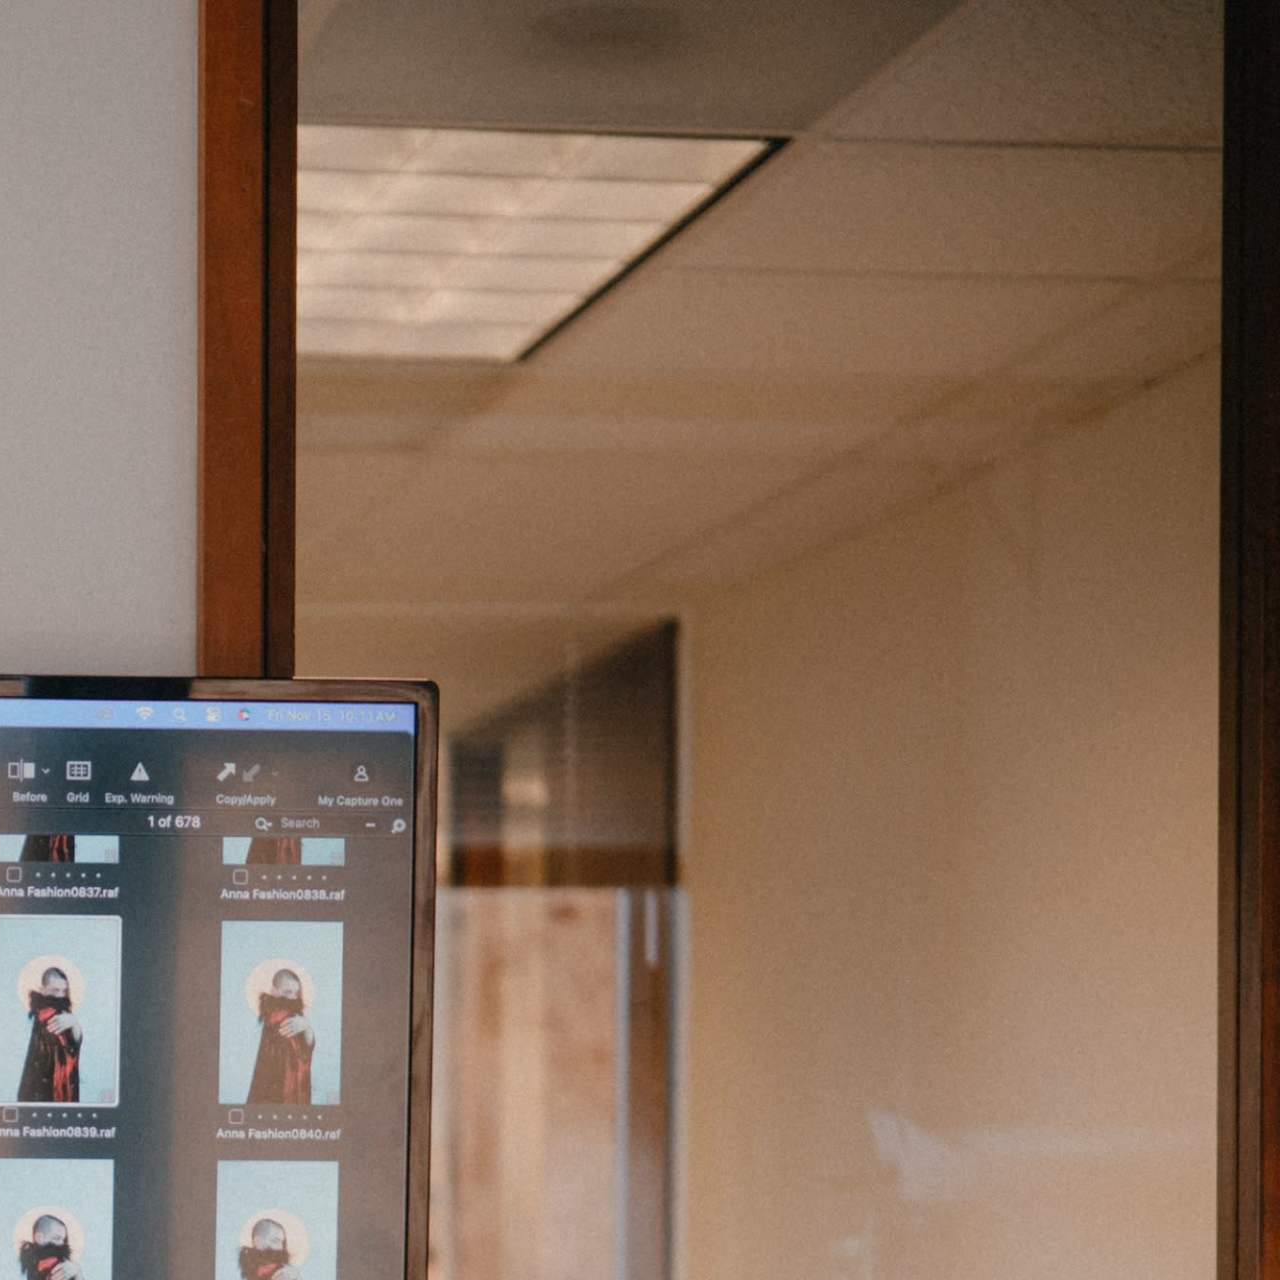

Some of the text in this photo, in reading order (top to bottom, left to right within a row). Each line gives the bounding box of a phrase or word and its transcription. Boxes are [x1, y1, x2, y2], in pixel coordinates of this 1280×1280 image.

[268, 710, 283, 721] Fri
[289, 711, 311, 721] Nov
[12, 791, 48, 803] Before
[66, 792, 90, 803] Grid
[105, 793, 175, 806] Exp. Warning
[215, 793, 277, 806] Copy/Apply
[318, 796, 403, 807] My Capture One
[147, 815, 201, 828] 1 of 678
[280, 817, 321, 829] Search
[27, 886, 120, 898] Fashion0837.raf
[220, 888, 249, 900] Anna
[22, 1126, 116, 1139] Fashion0839.raf
[216, 1128, 341, 1141] Anna Fashion0840.raf
